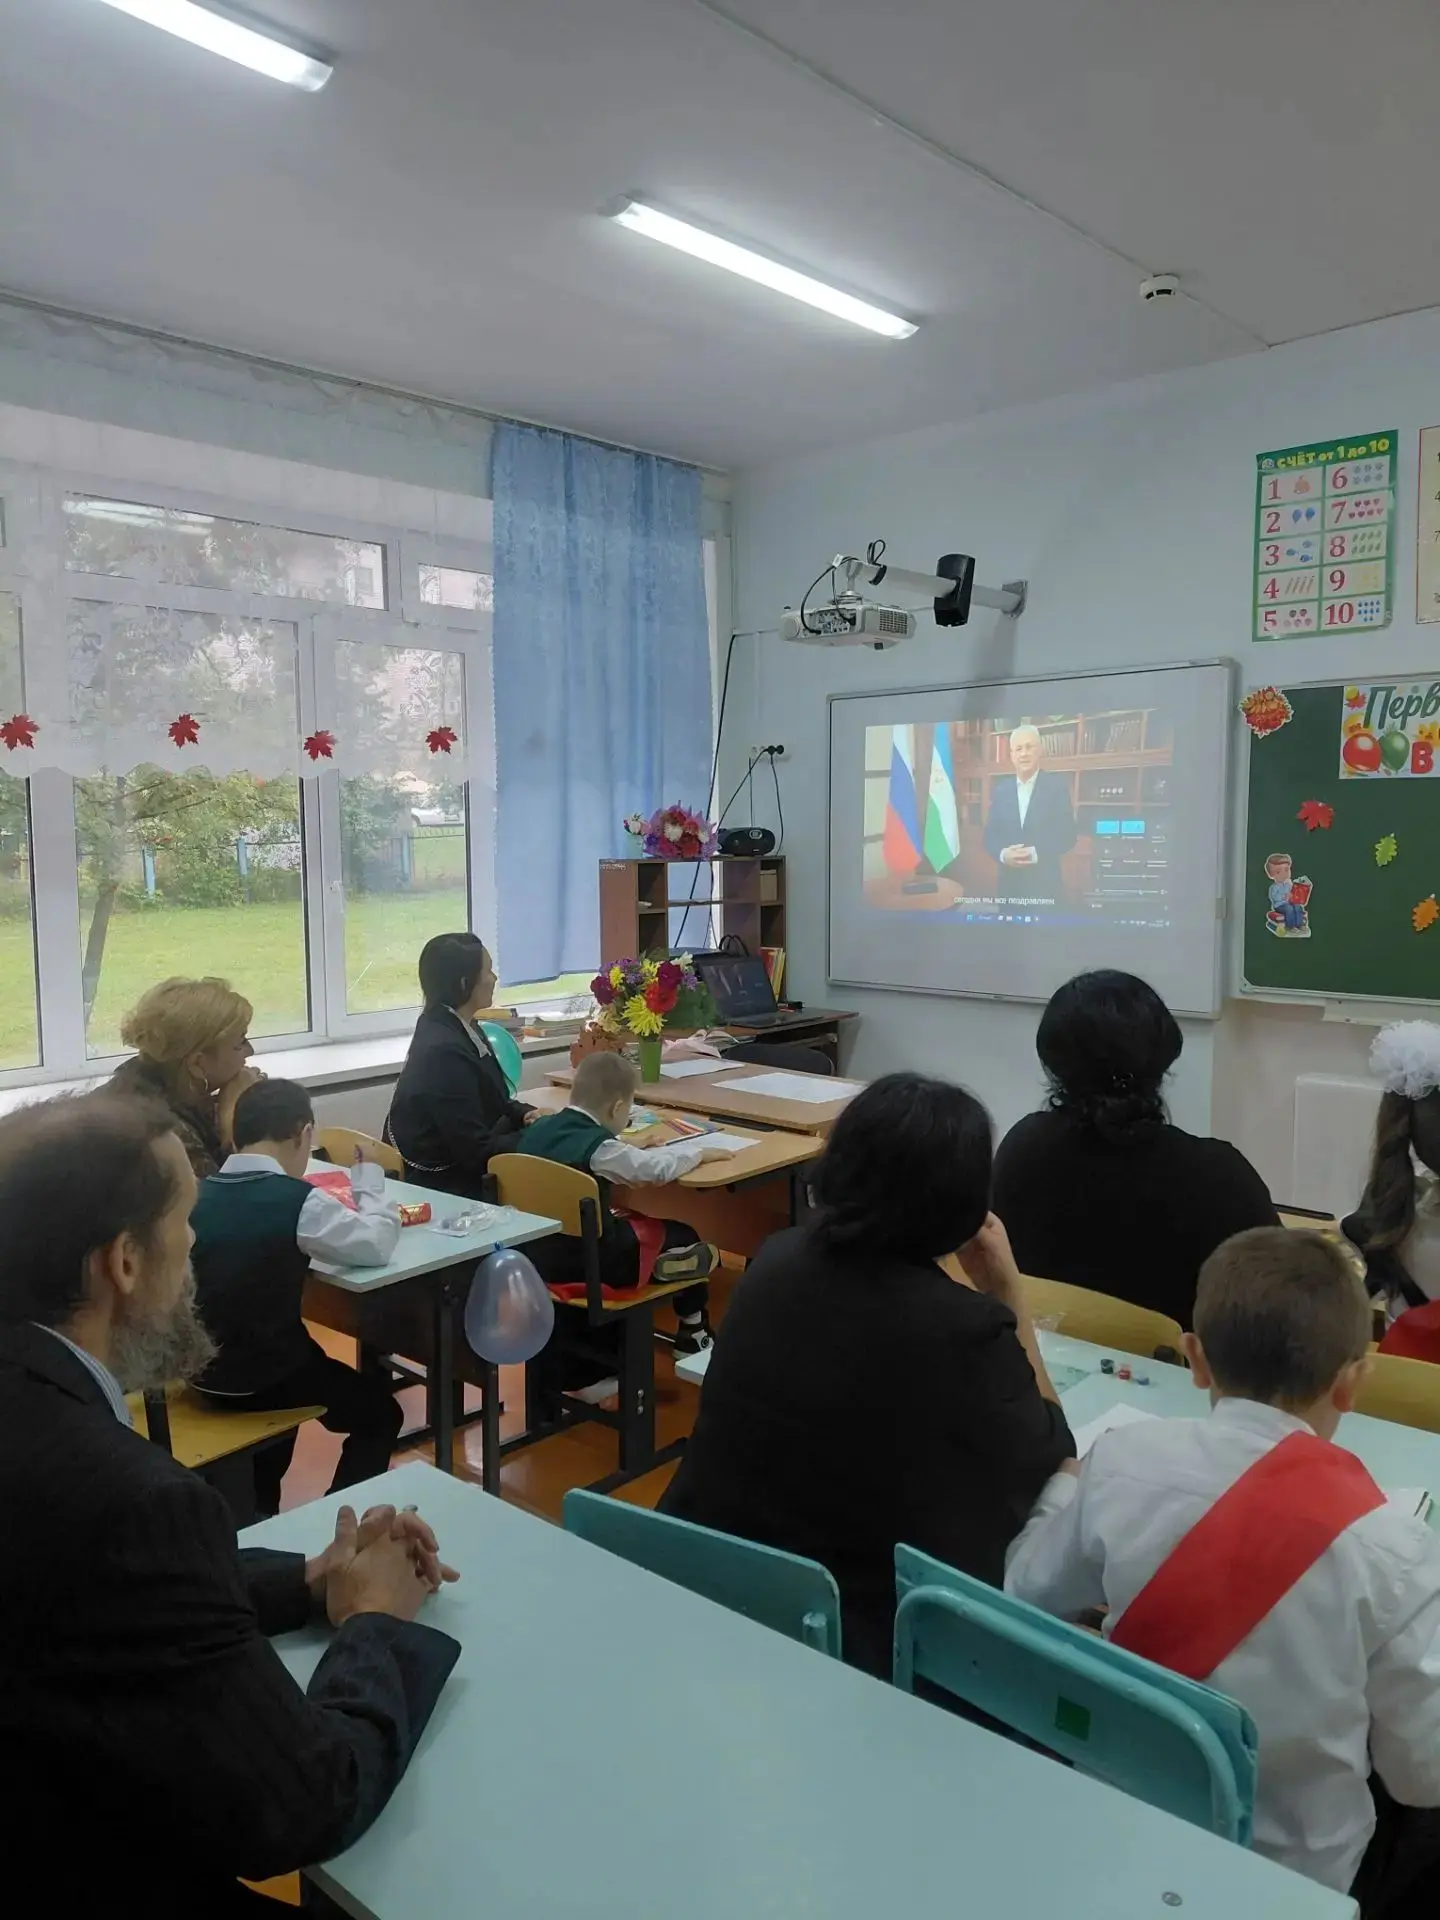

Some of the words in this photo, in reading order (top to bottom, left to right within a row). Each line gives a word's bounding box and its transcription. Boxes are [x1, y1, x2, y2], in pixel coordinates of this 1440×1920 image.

[1277, 452, 1316, 468] СЧЁТ
[1318, 452, 1334, 462] от
[1336, 446, 1345, 458] 1
[1348, 446, 1367, 458] до
[1369, 438, 1390, 453] 10
[1268, 478, 1281, 500] 1
[1332, 467, 1348, 489] 6
[1266, 512, 1281, 533] 2
[1331, 501, 1347, 524] 7
[1265, 545, 1280, 566] 3
[1329, 535, 1346, 557] 8
[1263, 578, 1280, 599] 4
[1329, 570, 1345, 591] 9
[1263, 610, 1277, 632] 5
[1325, 602, 1354, 626] 10
